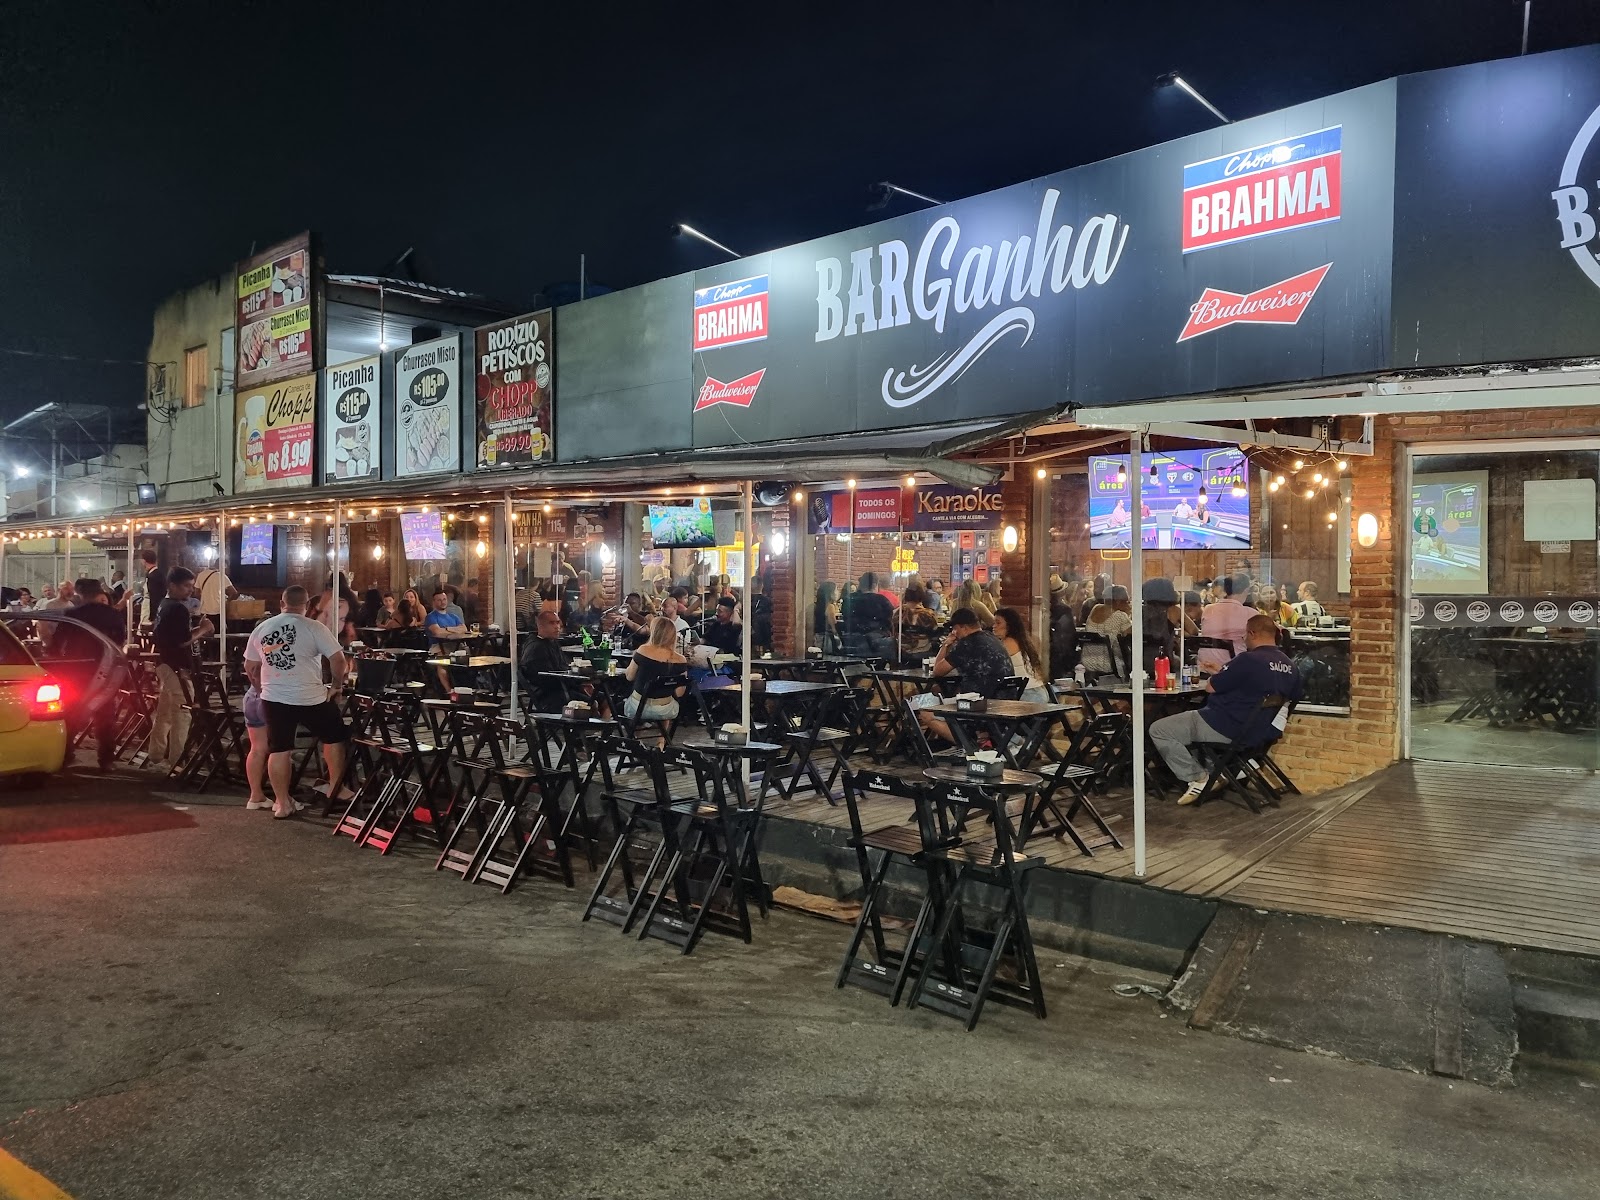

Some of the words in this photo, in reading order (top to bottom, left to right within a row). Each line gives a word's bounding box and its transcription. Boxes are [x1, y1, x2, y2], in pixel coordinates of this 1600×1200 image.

[1191, 166, 1331, 238] BRAHMA
[242, 266, 271, 289] Picanha
[713, 284, 752, 302] Chopp
[1190, 290, 1314, 325] Budweiser
[698, 301, 763, 342] BRAHMA
[488, 319, 539, 352] RODÍZIO
[403, 351, 436, 372] Churrasco
[436, 346, 456, 364] Misto
[481, 340, 546, 376] PETISCOS
[332, 364, 374, 391] Picanha
[504, 368, 521, 384] COM
[492, 380, 538, 410] CHOPP
[700, 383, 758, 402] Budweiser
[266, 387, 313, 427] Chopp
[267, 451, 280, 474] R$
[858, 499, 883, 507] TODOS
[885, 498, 895, 506] OS
[917, 489, 1002, 514] Karaoke
[857, 511, 896, 520] DOMINGOS
[1269, 661, 1292, 674] SAÚDE
[971, 763, 985, 772] 065
